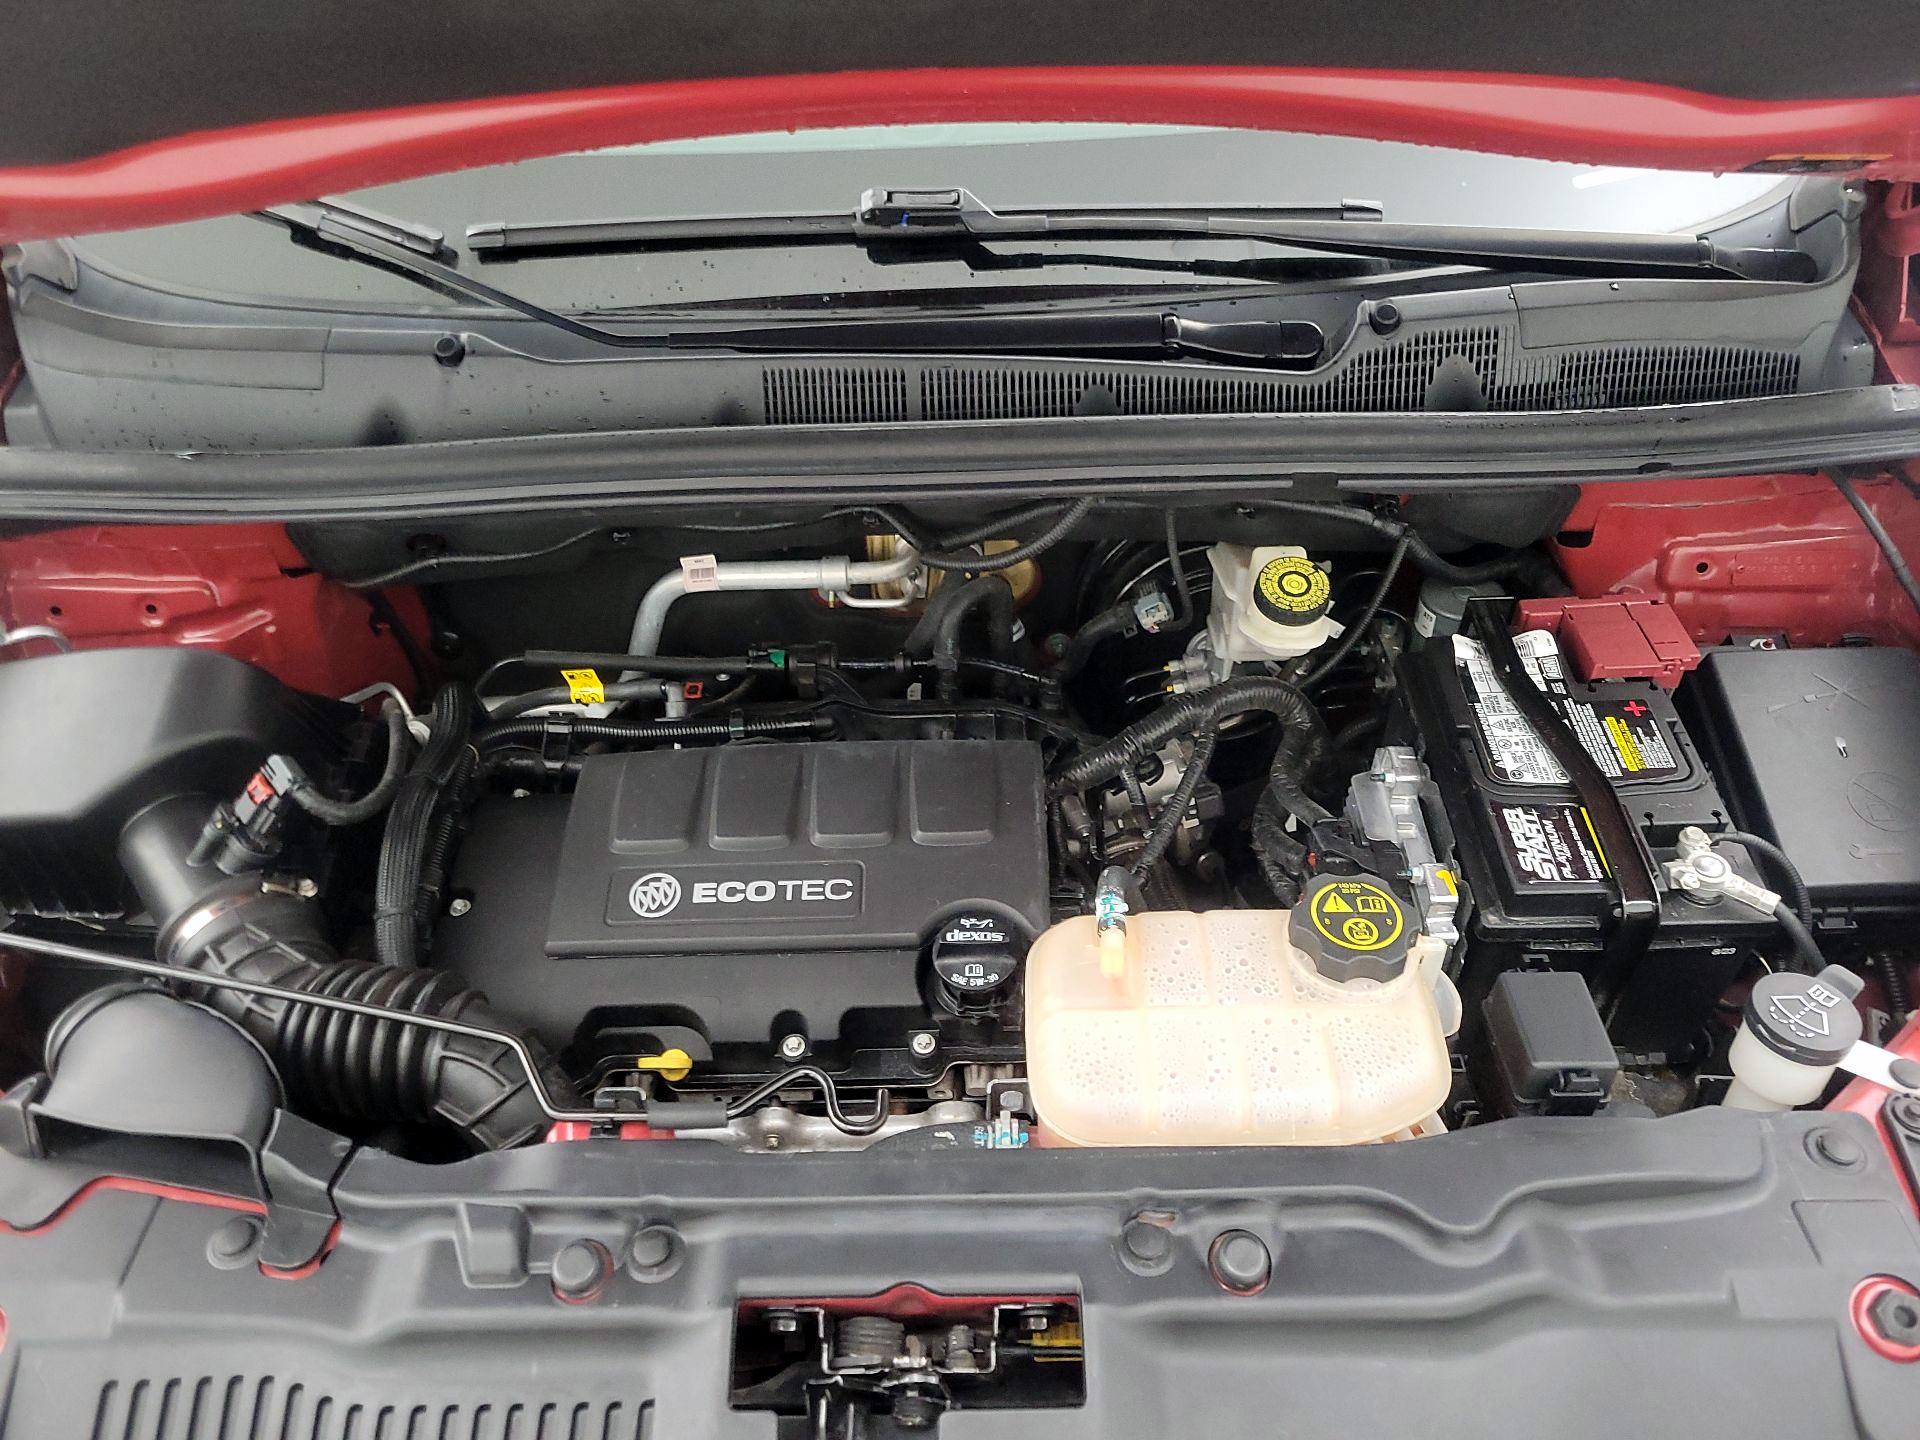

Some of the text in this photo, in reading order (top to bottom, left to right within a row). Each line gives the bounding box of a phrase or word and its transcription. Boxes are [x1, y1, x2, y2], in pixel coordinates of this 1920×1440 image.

[1502, 808, 1533, 872] SUPER
[1516, 807, 1561, 881] START
[1542, 820, 1575, 879] PLATINUM
[692, 879, 854, 903] ECOTEC
[946, 929, 1005, 941] dexos
[951, 973, 999, 986] SAE 5W-30
